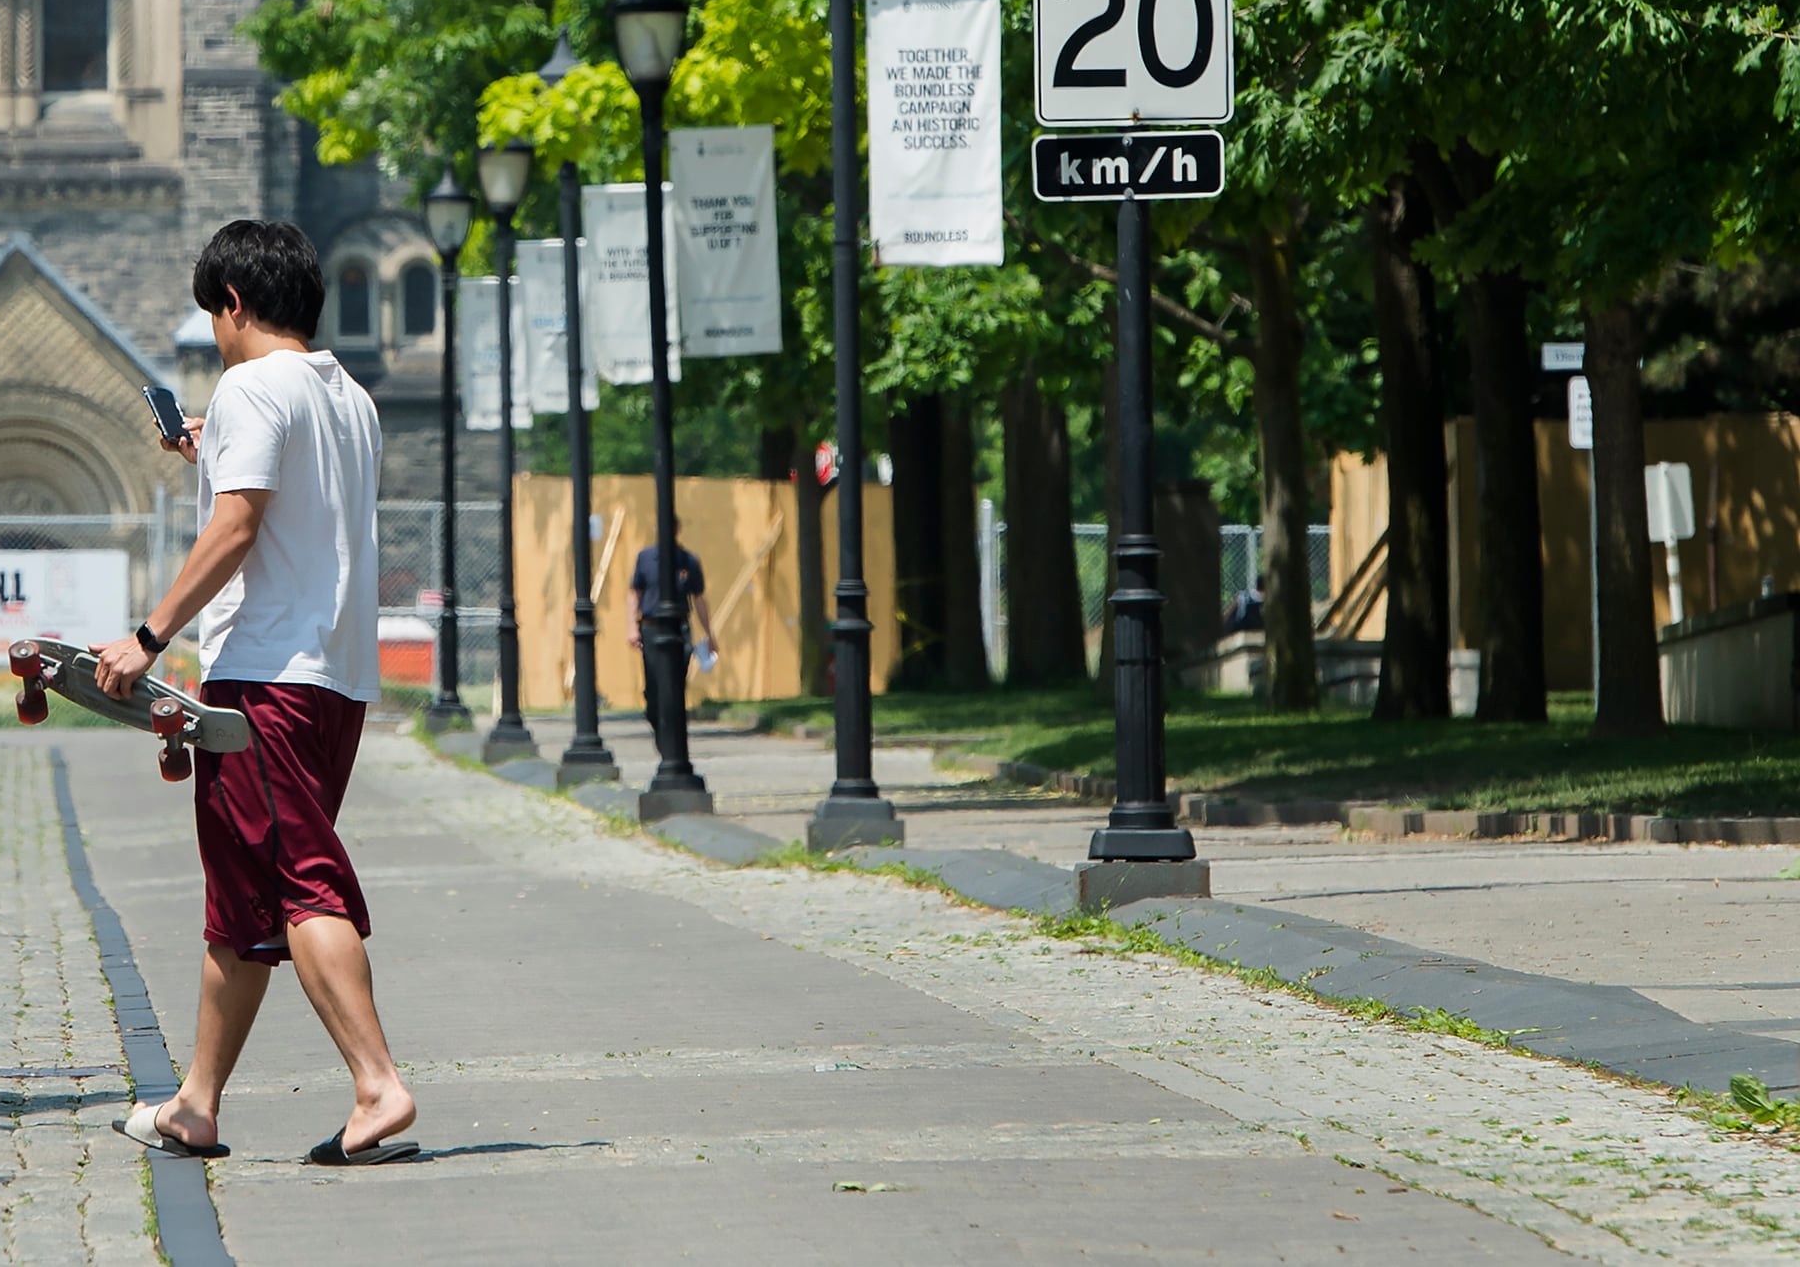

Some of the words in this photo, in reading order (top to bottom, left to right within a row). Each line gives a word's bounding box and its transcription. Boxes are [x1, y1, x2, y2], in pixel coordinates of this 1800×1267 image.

[898, 48, 972, 64] TOGETHER,
[885, 67, 907, 81] WE
[912, 66, 952, 80] MADE
[957, 64, 983, 79] THE
[894, 83, 975, 97] BOUNDLESS
[899, 100, 971, 115] CAMPAIGN
[892, 119, 913, 132] AN
[917, 118, 980, 132] HISTORIC
[904, 135, 972, 150] SUCCESS.
[1059, 146, 1198, 186] km/h
[691, 197, 728, 208] THANK
[733, 196, 755, 206] YOU
[904, 230, 968, 243] BOUNDLESS
